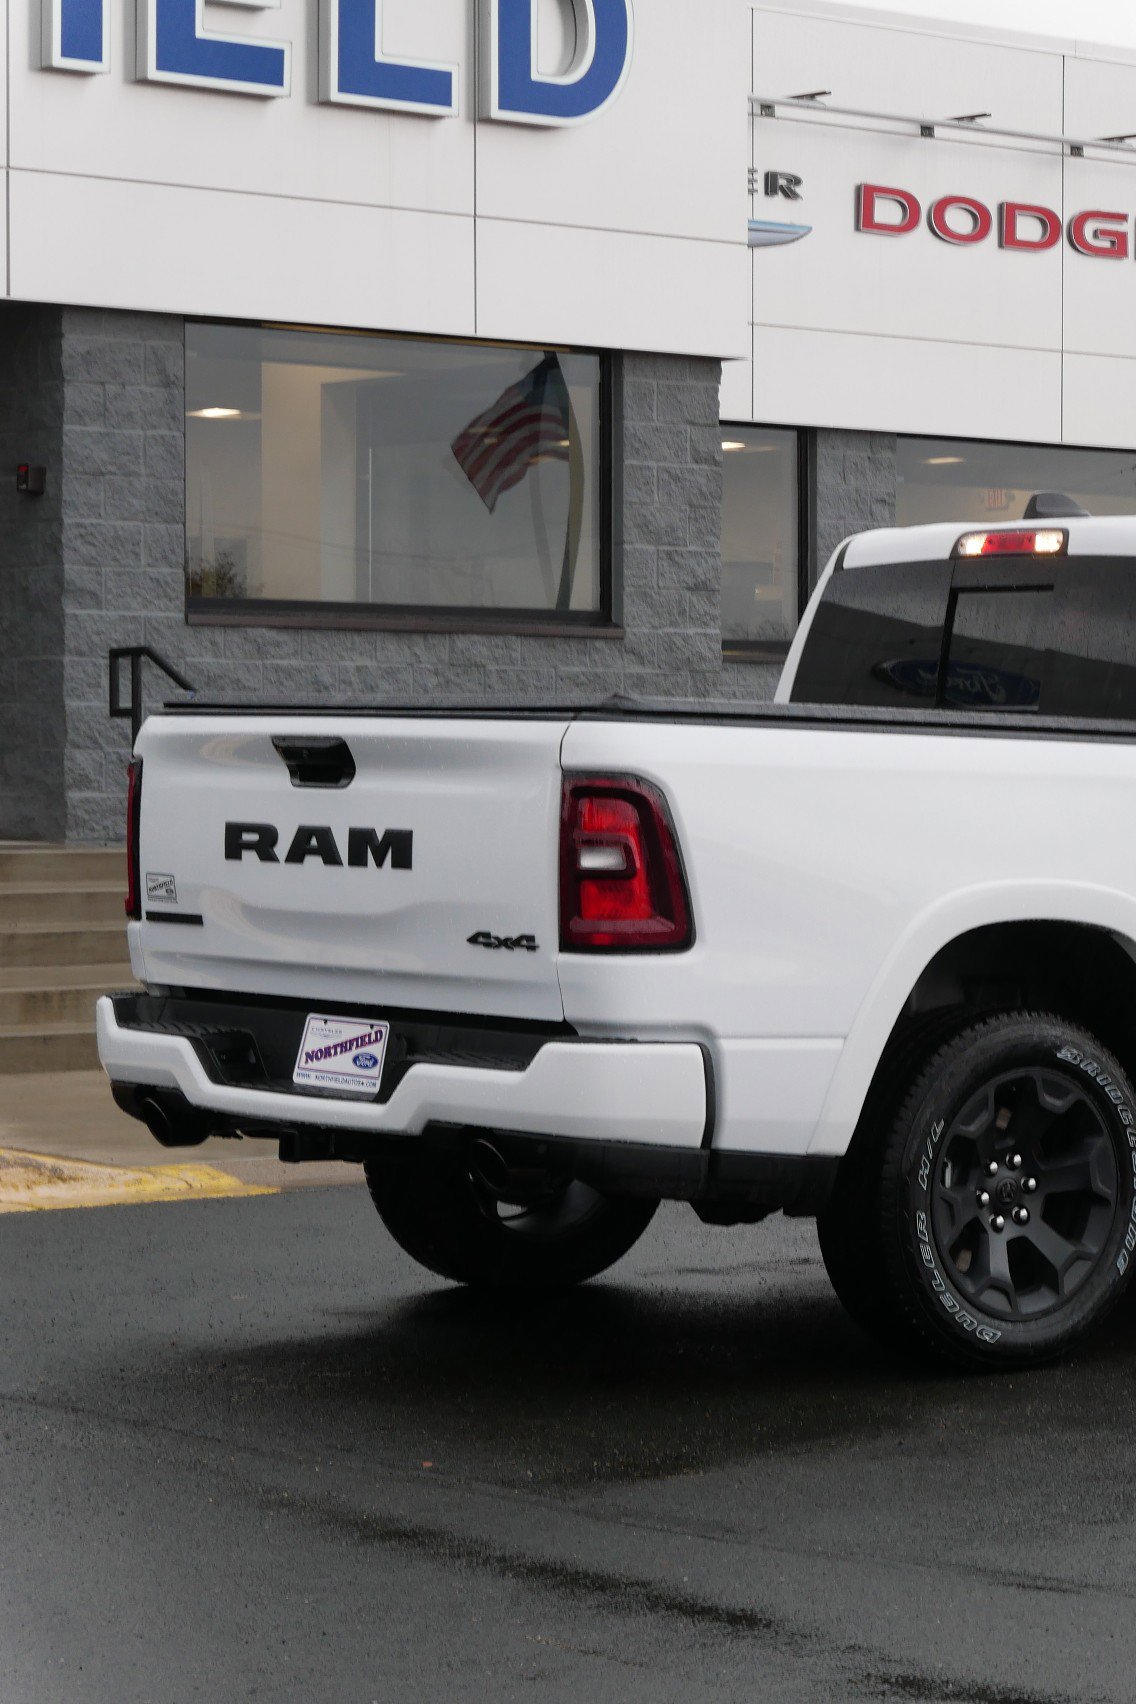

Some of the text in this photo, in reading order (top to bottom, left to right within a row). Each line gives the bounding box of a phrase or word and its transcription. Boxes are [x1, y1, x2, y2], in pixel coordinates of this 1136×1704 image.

[747, 168, 803, 201] R
[224, 821, 414, 870] RAM
[466, 930, 539, 952] 4x4
[304, 1029, 383, 1064] NORTHFIELD
[916, 1209, 1003, 1344] DUELER
